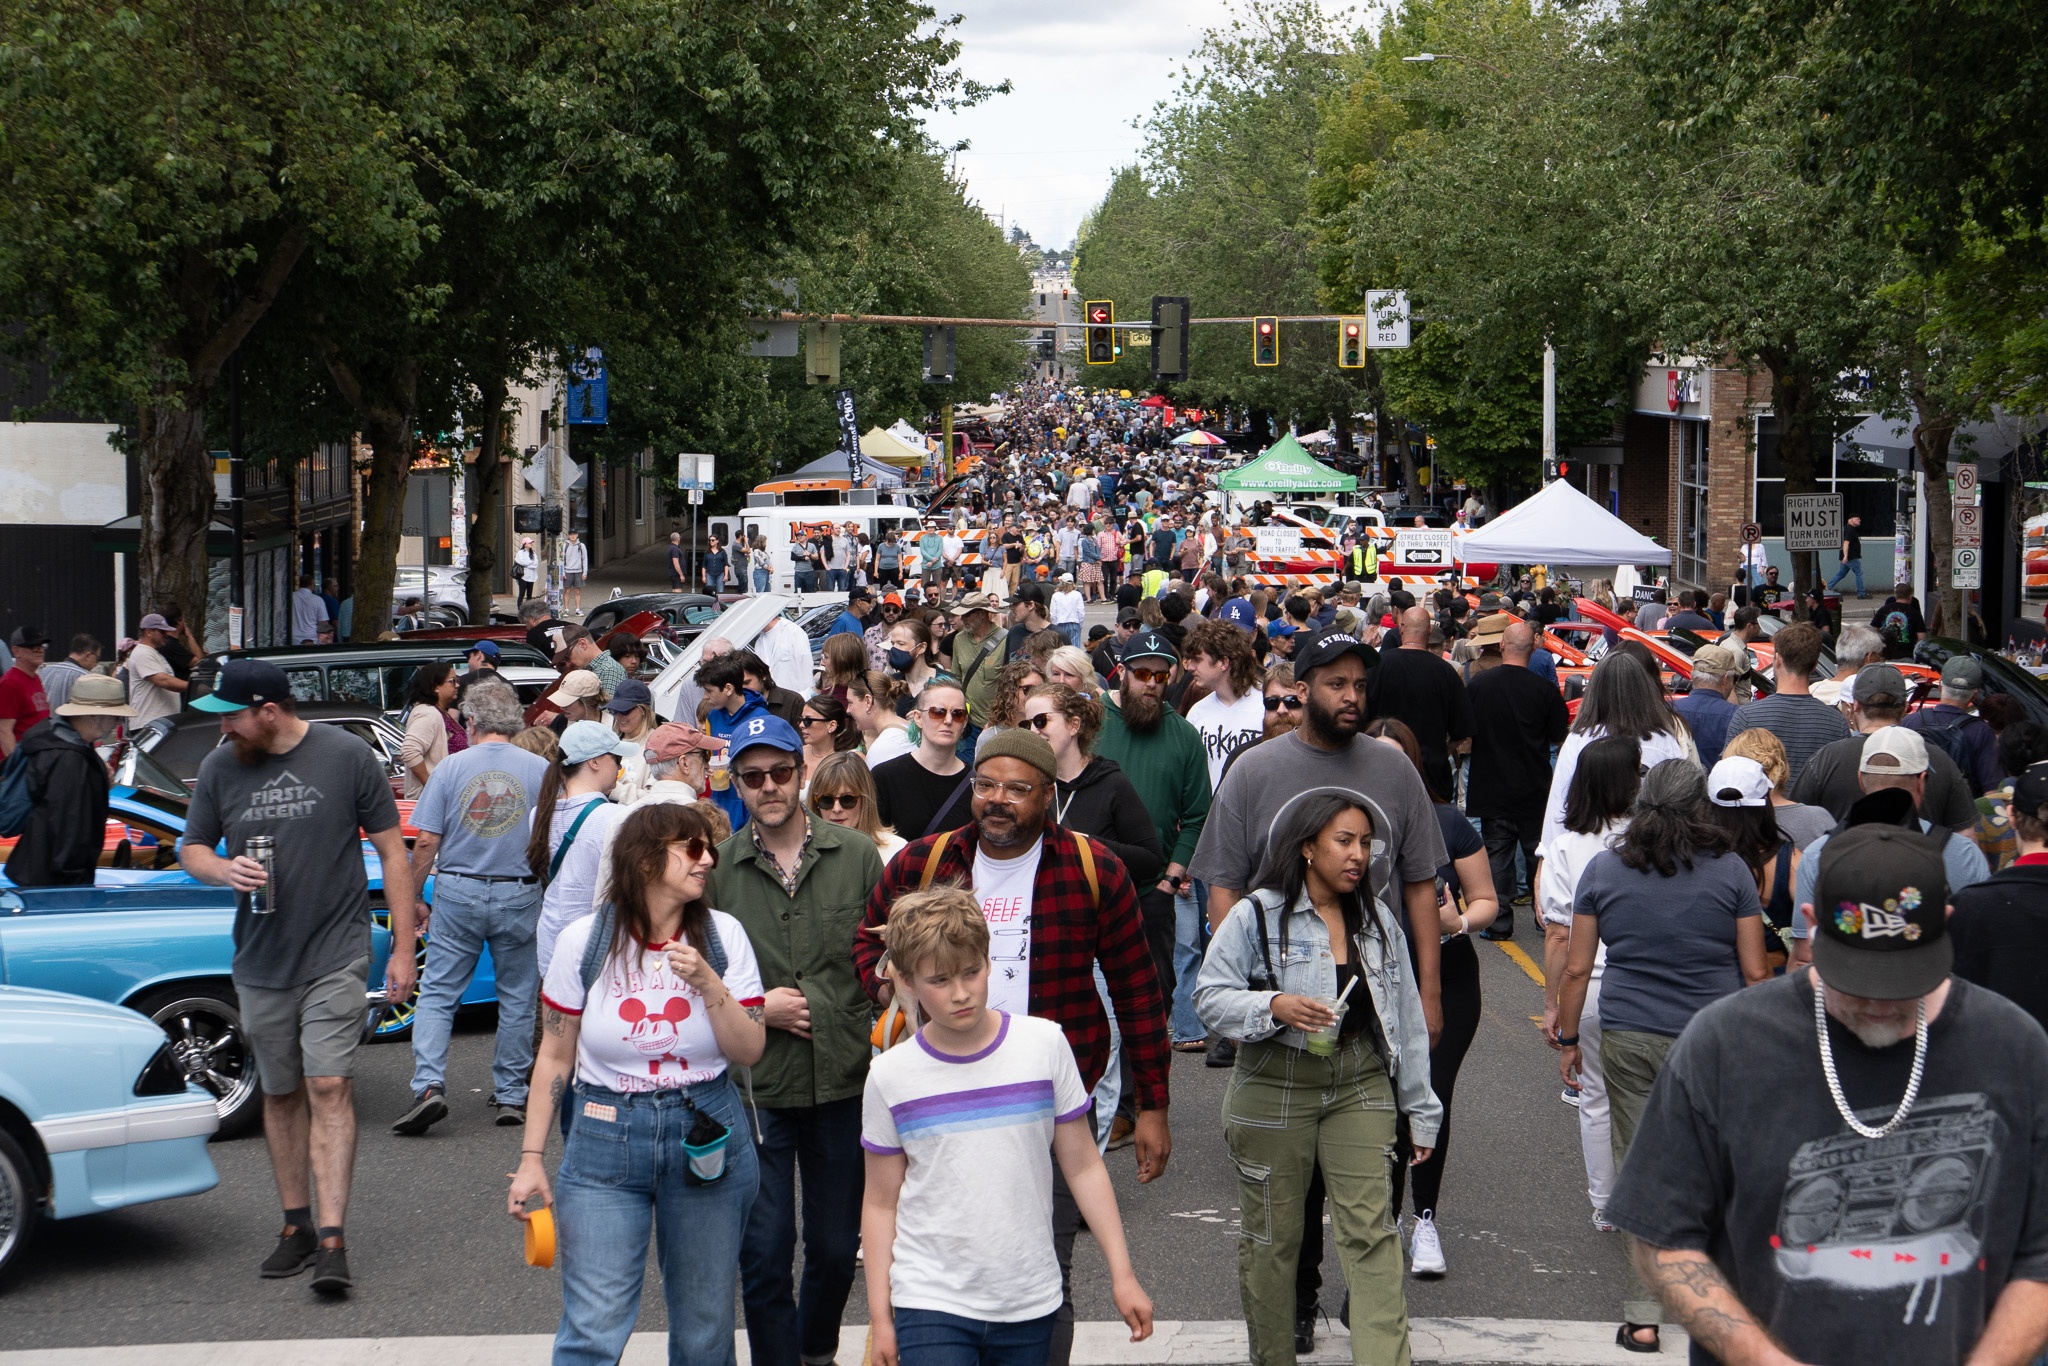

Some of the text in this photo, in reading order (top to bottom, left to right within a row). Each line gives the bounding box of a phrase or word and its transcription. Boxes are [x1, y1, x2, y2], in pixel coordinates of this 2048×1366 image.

[1378, 333, 1397, 342] RED
[1240, 478, 1342, 489] www.oreillyauto.com
[1787, 497, 1840, 508] RIGHT LANE
[1791, 510, 1838, 527] MUST
[1276, 530, 1297, 538] CLOSED
[1789, 529, 1839, 539] TURN RIGHT
[1275, 546, 1297, 554] TRAFFIC
[1791, 540, 1816, 548] EXCEPT
[1634, 589, 1655, 600] DANC
[1230, 605, 1241, 620] LA
[1317, 633, 1359, 649] ETHIOP
[748, 718, 766, 736] B
[463, 773, 522, 799] HOTEL DEL CORONADO
[250, 785, 306, 806] FIRST
[240, 800, 317, 823] ASCENT
[610, 970, 704, 999] SHAN
[616, 1070, 715, 1093] CLEVELAND
